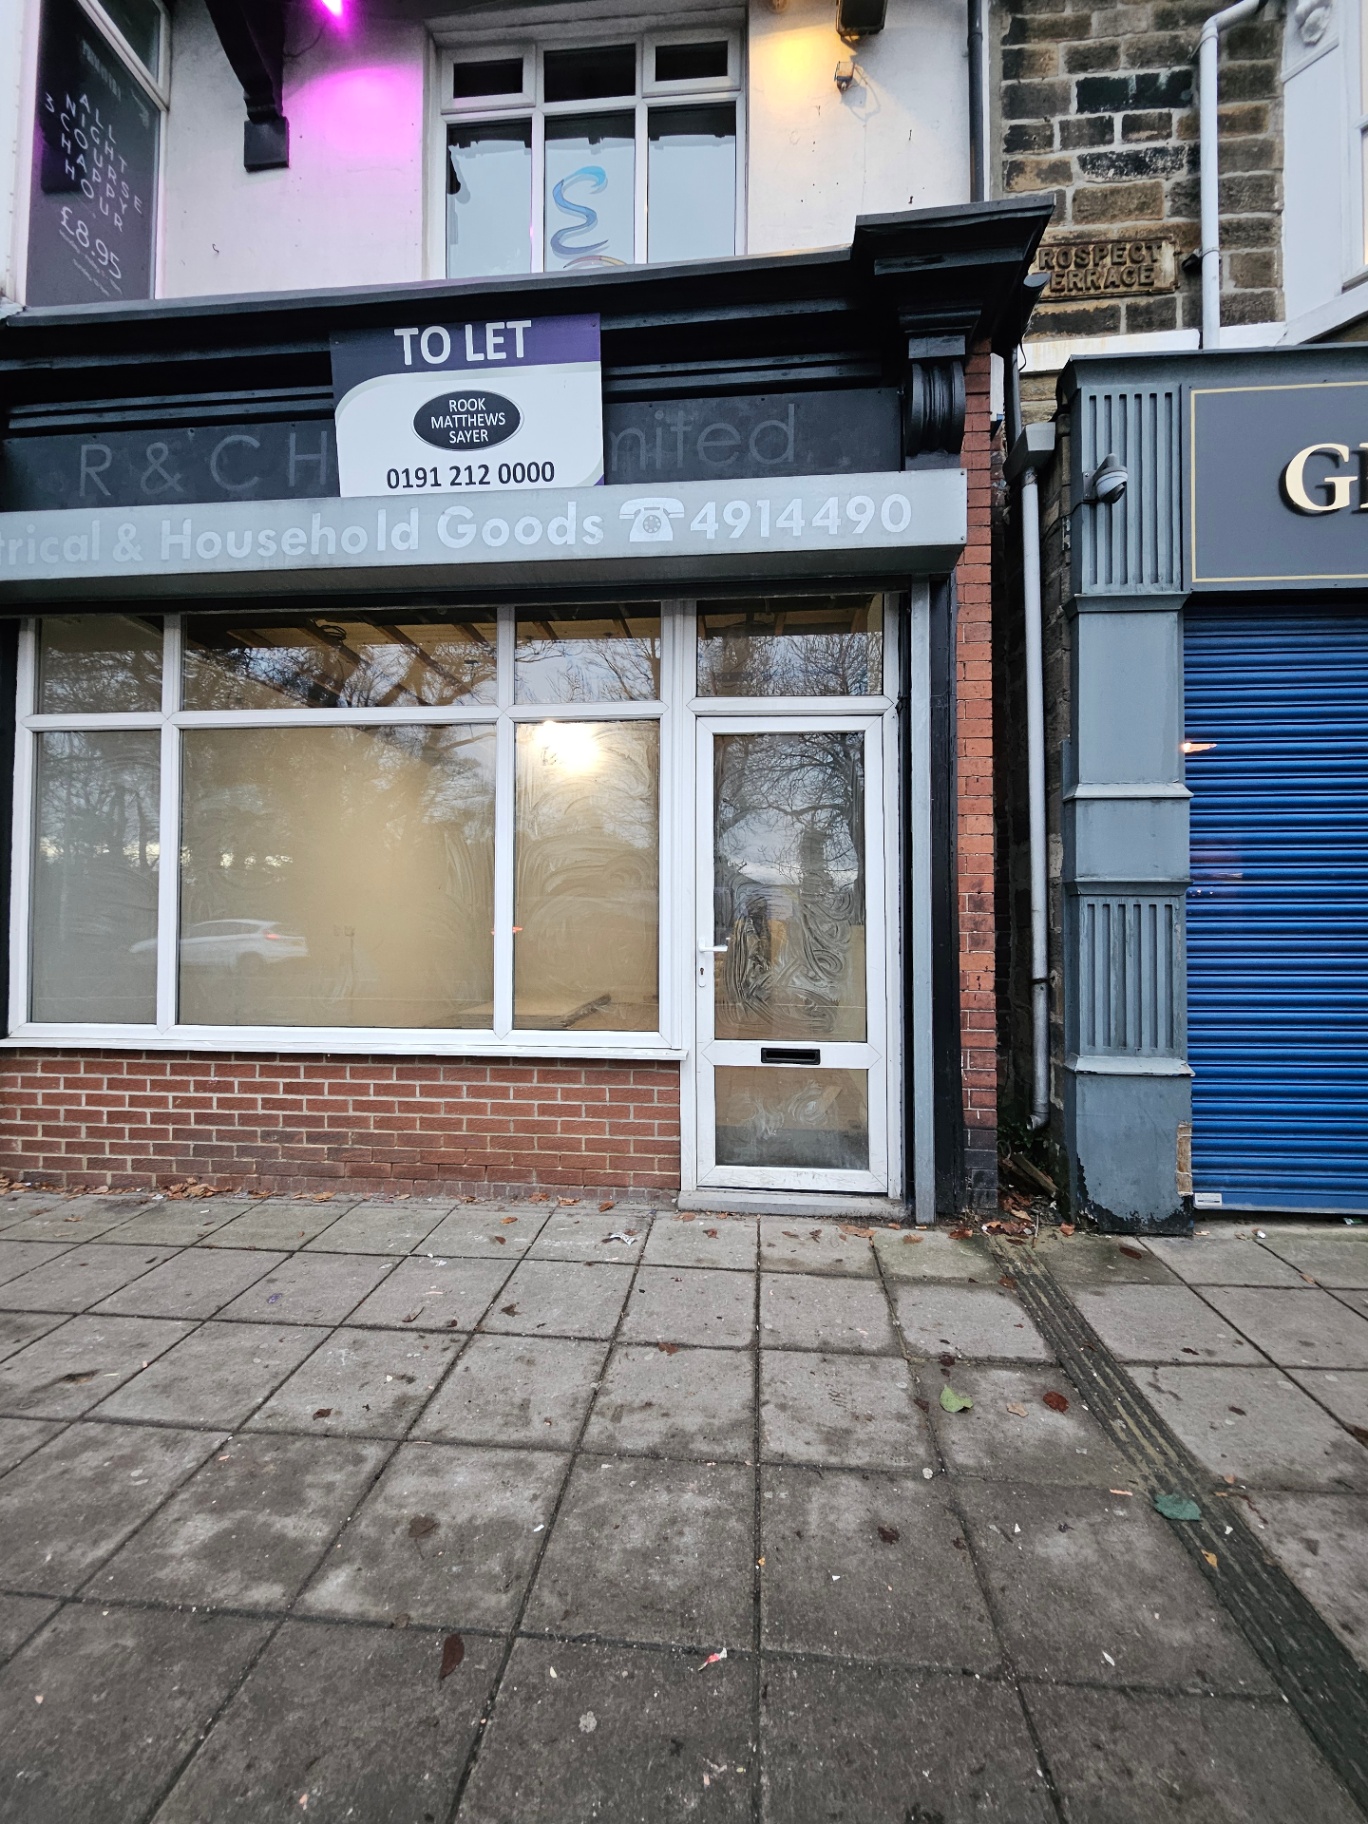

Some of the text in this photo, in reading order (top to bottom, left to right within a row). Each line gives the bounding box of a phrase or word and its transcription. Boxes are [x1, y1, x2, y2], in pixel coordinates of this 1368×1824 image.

[60, 206, 122, 280] £8.95
[1031, 241, 1162, 271] ROSPECT
[1049, 264, 1155, 293] ERRACE
[393, 319, 532, 366] TO LET
[448, 397, 486, 413] ROOK
[431, 412, 506, 429] MATTHEWS
[448, 429, 489, 444] SAYER
[79, 444, 112, 497] R
[140, 441, 184, 495] &
[386, 461, 555, 489] 0191 212 0000
[1285, 442, 1368, 511] G
[112, 522, 143, 563] &
[160, 507, 419, 560] Household
[437, 501, 604, 549] Goods
[690, 493, 912, 540] 4914490
